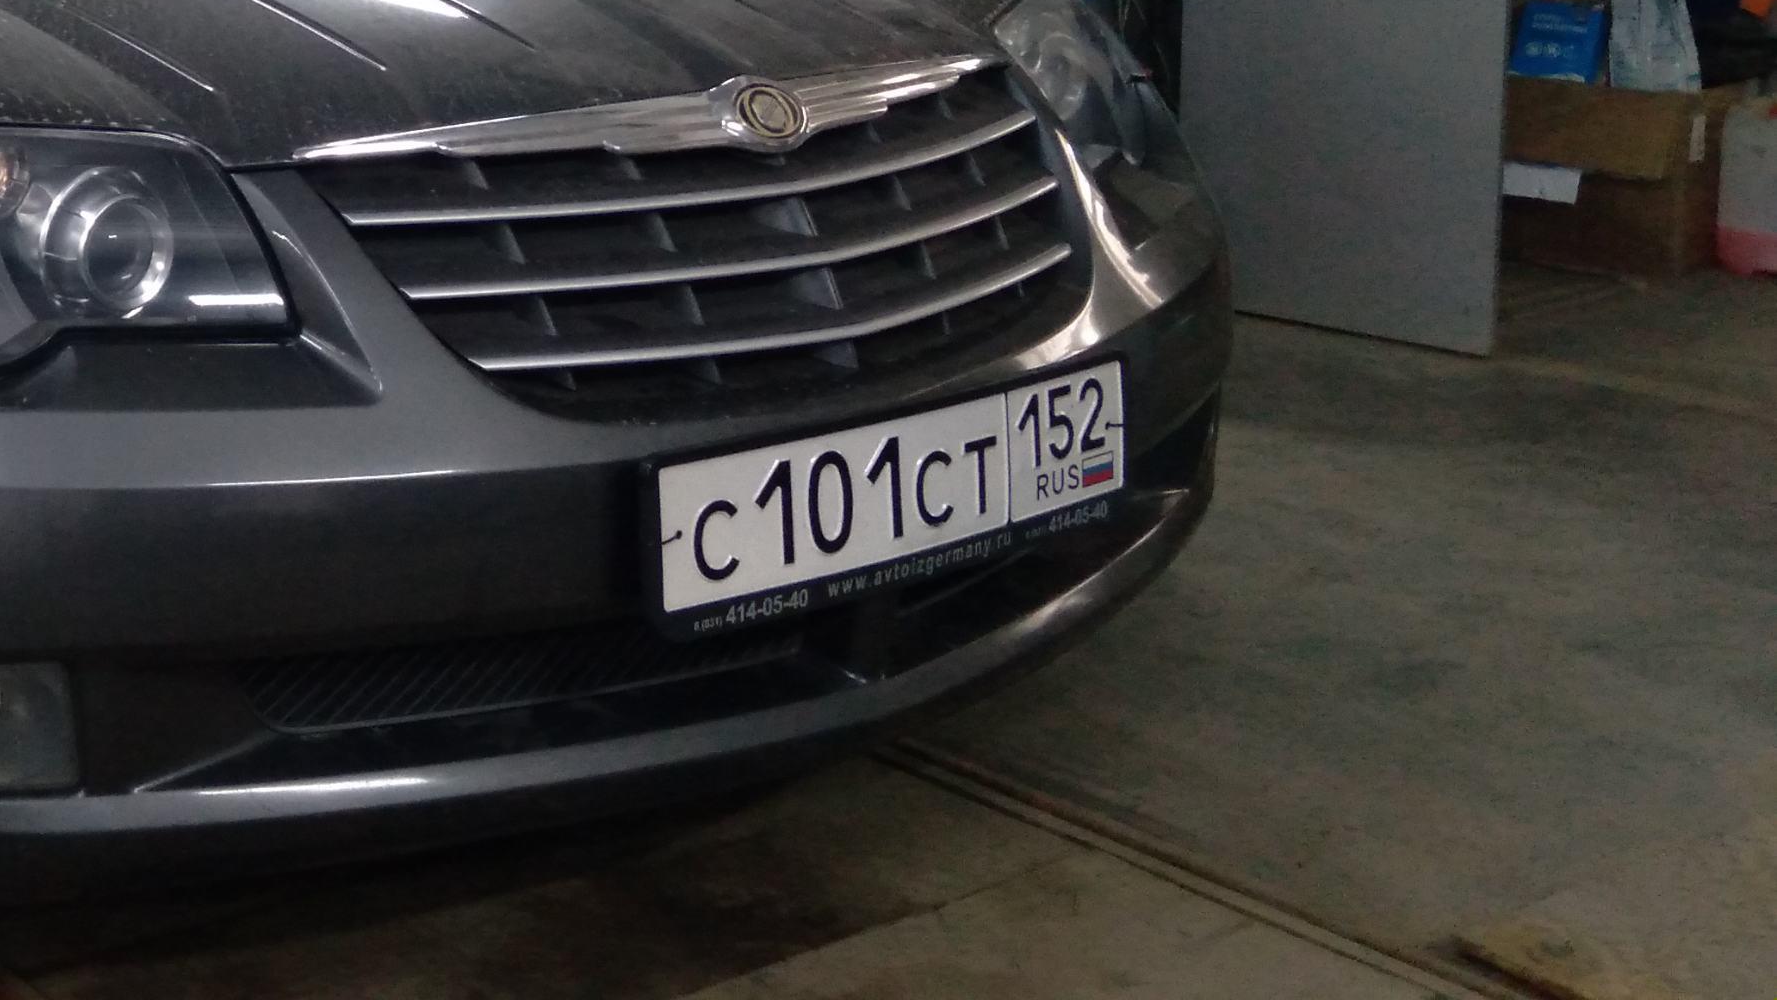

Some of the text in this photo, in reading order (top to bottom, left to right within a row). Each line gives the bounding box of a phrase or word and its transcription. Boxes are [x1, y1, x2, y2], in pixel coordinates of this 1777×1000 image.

[1016, 377, 1106, 470] 152
[1035, 464, 1081, 502] RUS
[826, 531, 1013, 599] www.avtoizgermany.ru
[725, 588, 810, 625] 414-05-40
